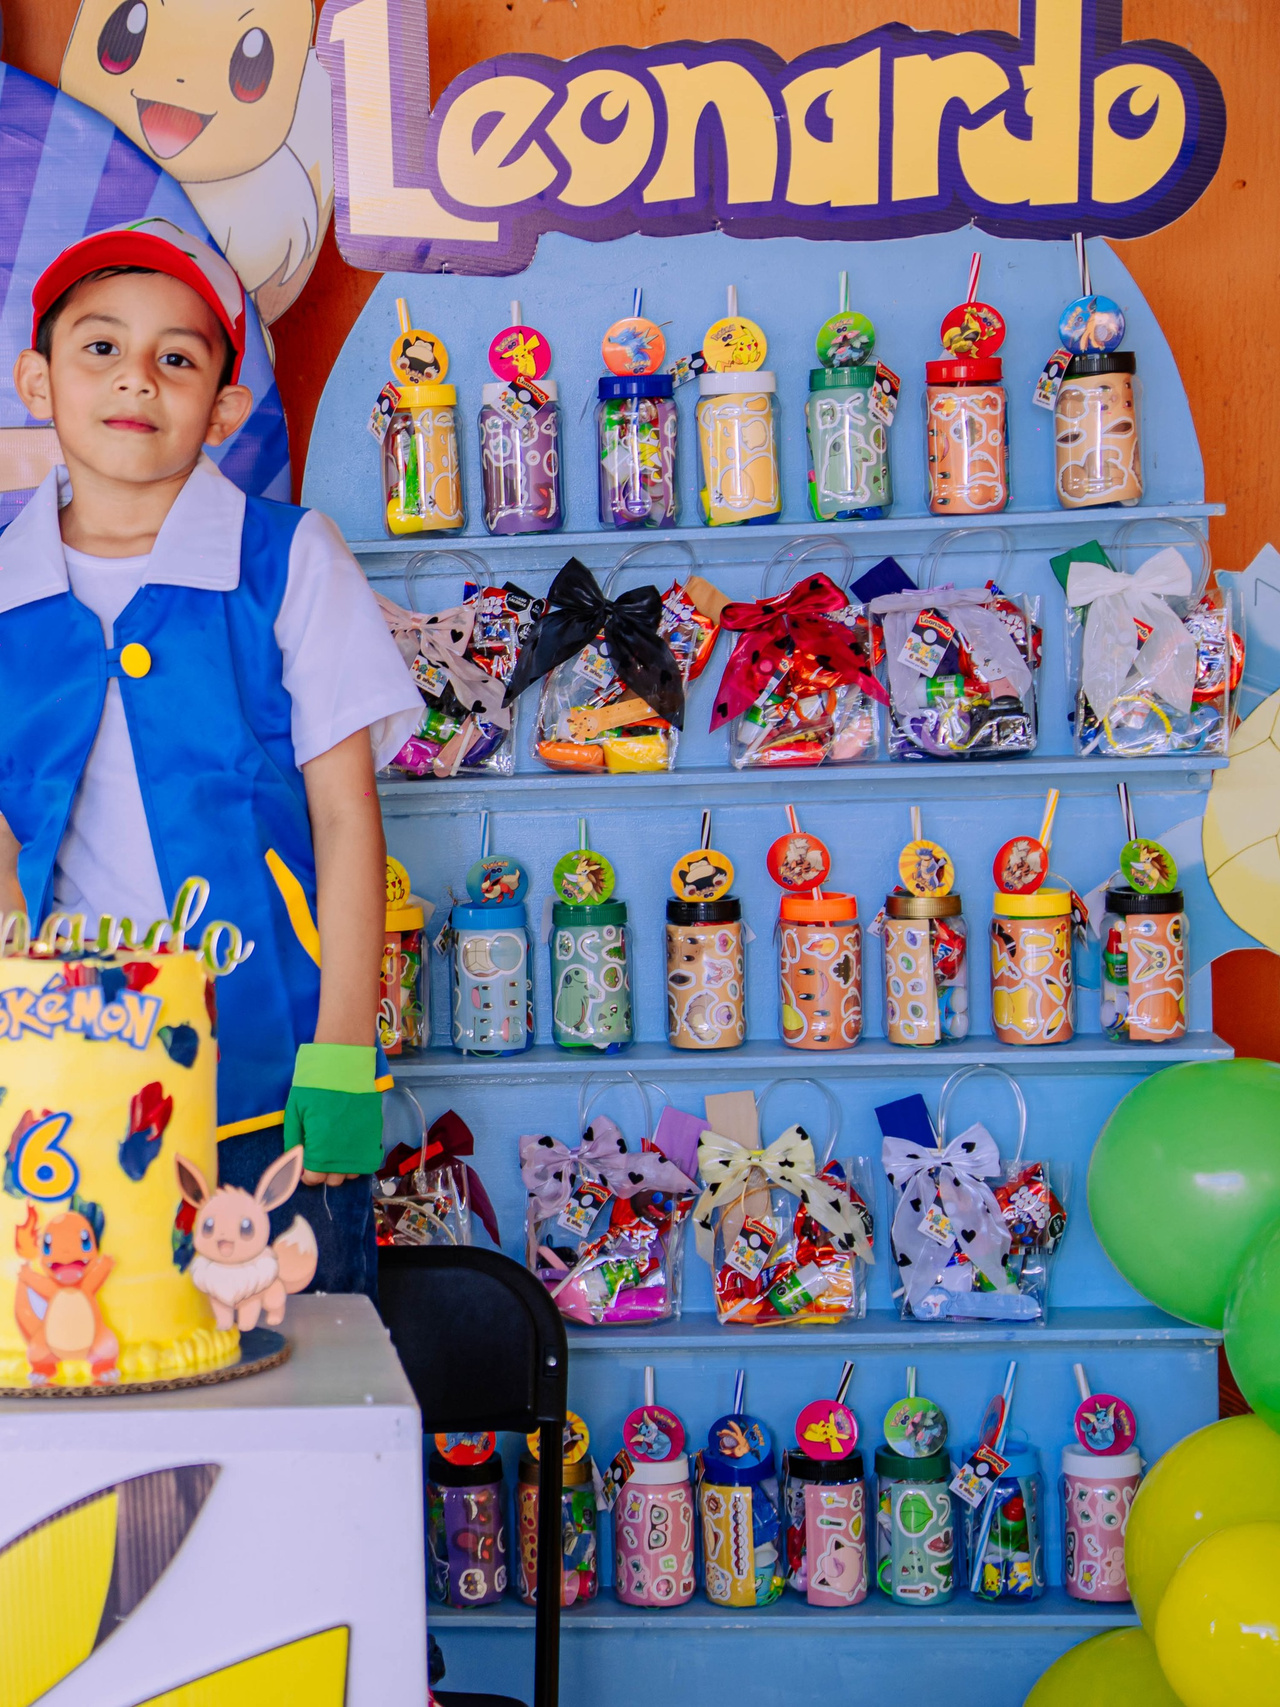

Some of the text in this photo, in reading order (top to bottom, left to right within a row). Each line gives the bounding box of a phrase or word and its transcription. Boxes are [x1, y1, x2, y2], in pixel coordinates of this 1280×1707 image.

[330, 0, 1187, 243] Leonardo
[920, 616, 952, 638] Leonardo
[915, 656, 929, 667] años
[14, 1112, 80, 1202] 6
[746, 1220, 774, 1242] Leonardo
[978, 1450, 1004, 1472] Leonardo
